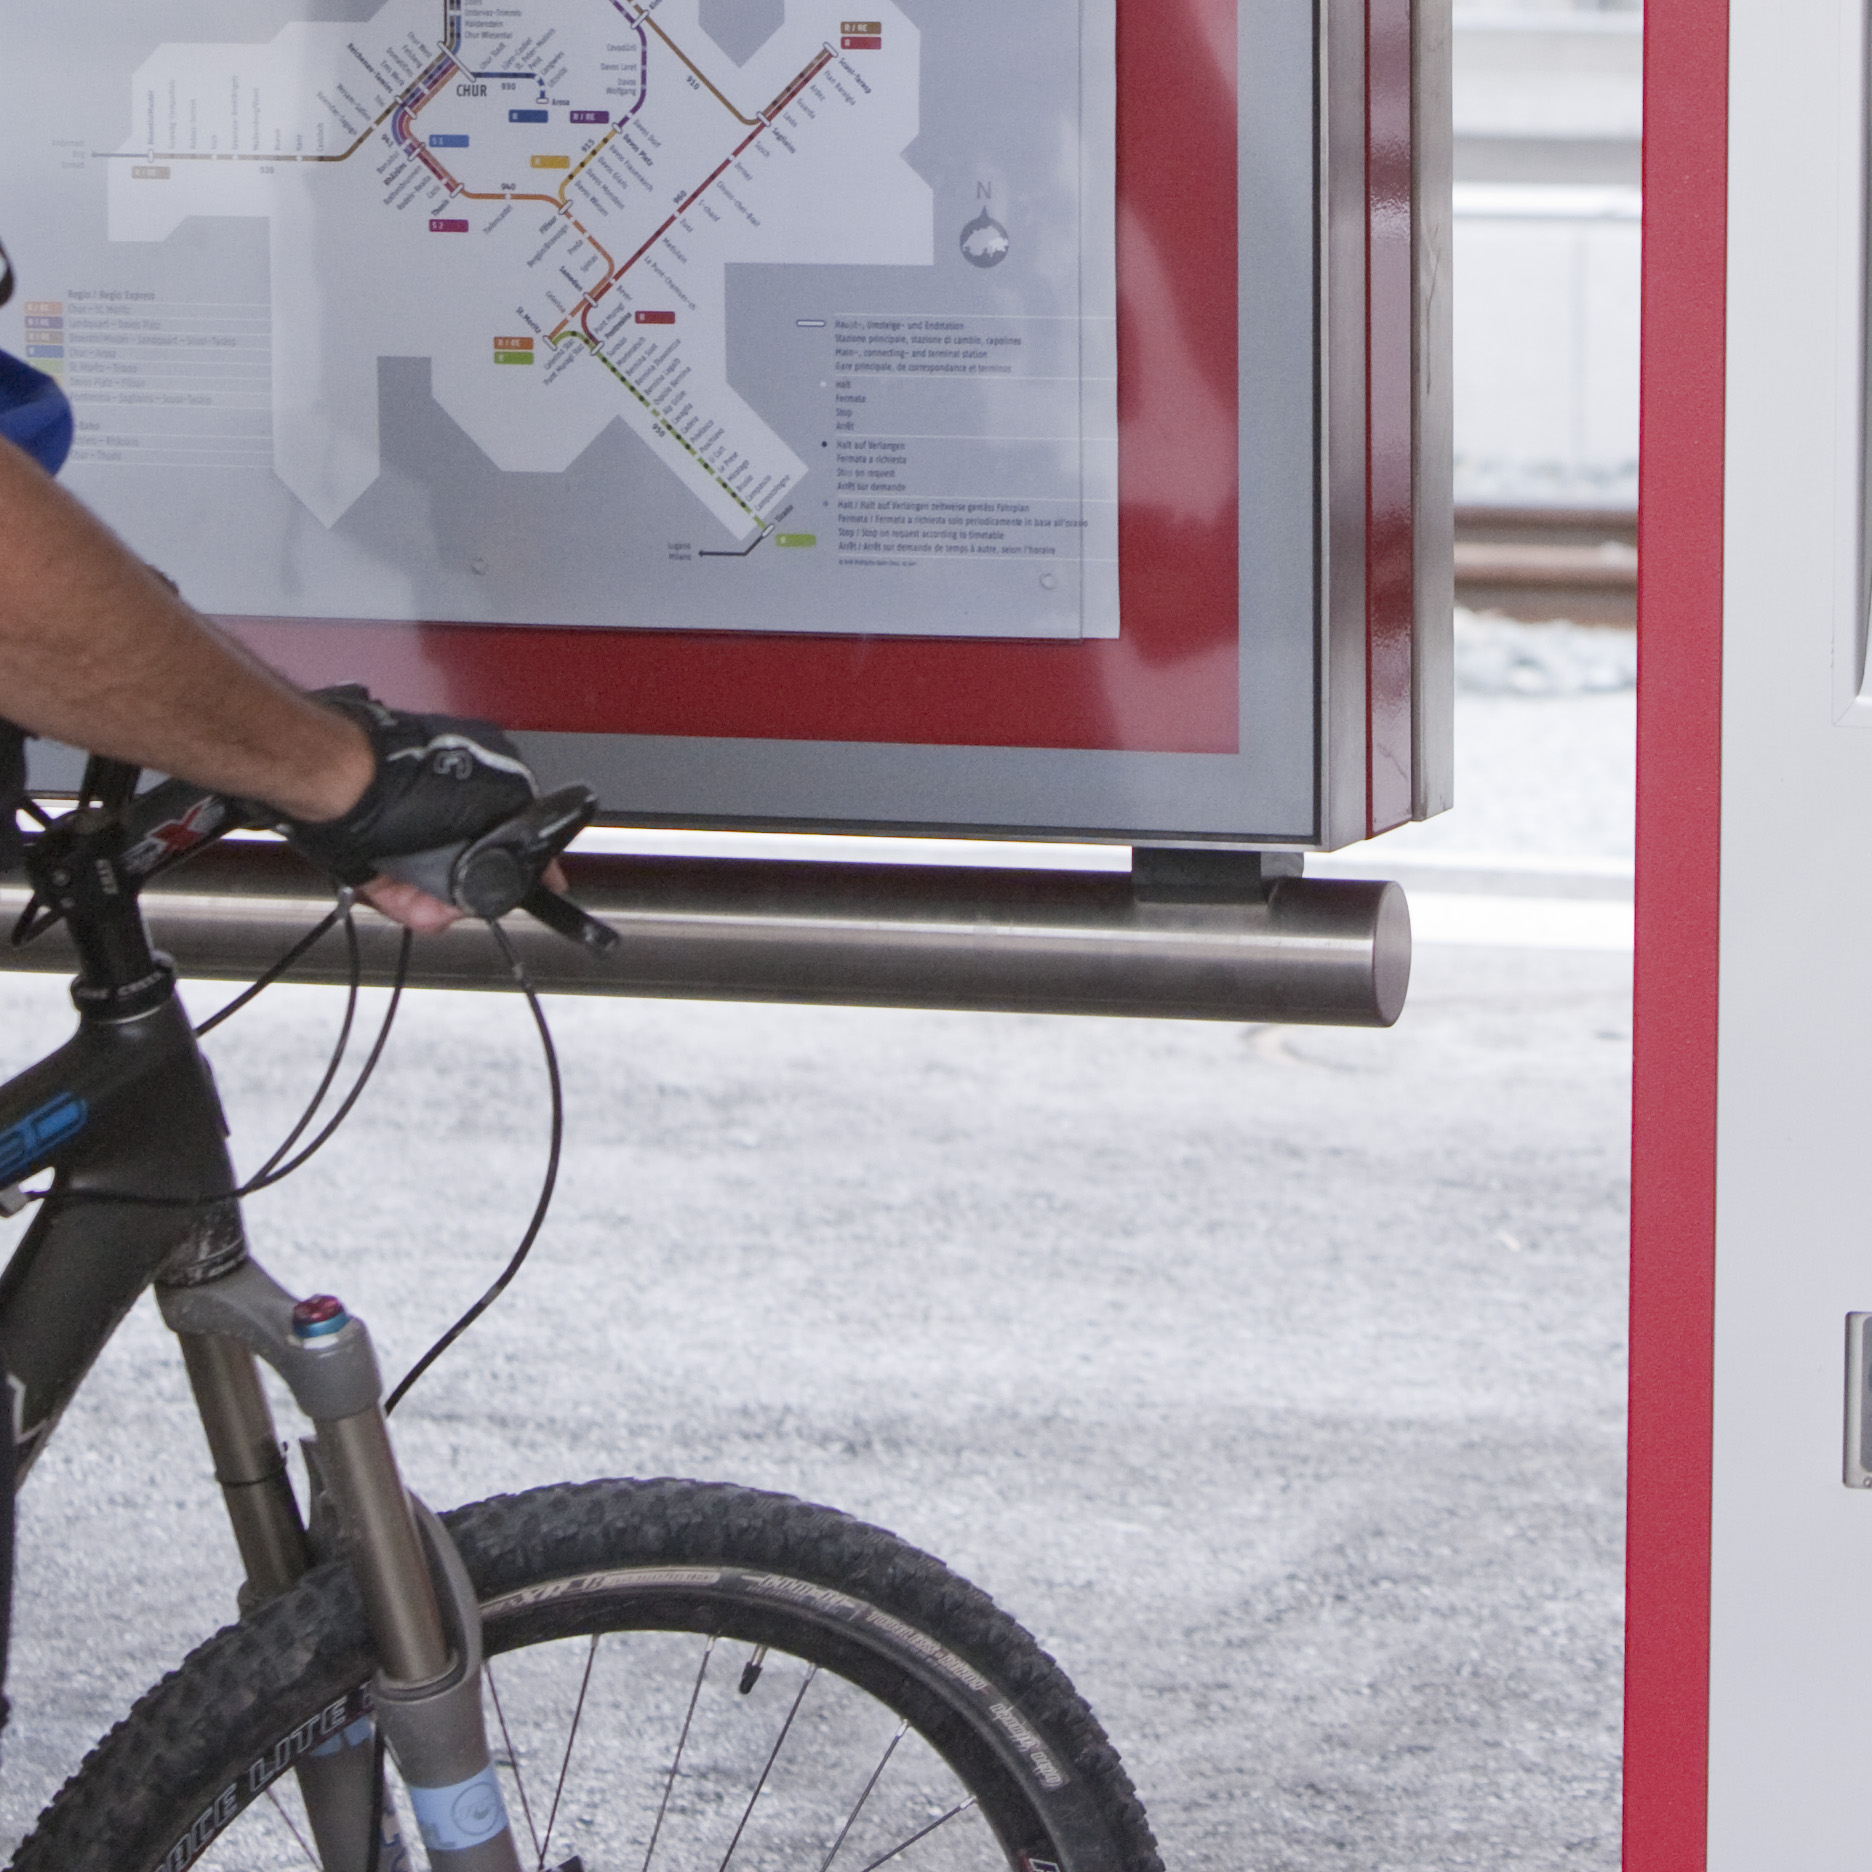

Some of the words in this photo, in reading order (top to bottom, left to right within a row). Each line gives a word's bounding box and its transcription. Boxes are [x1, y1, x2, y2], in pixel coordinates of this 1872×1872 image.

[455, 83, 489, 98] CHUR
[975, 181, 992, 200] N
[248, 1695, 348, 1794] LITE
